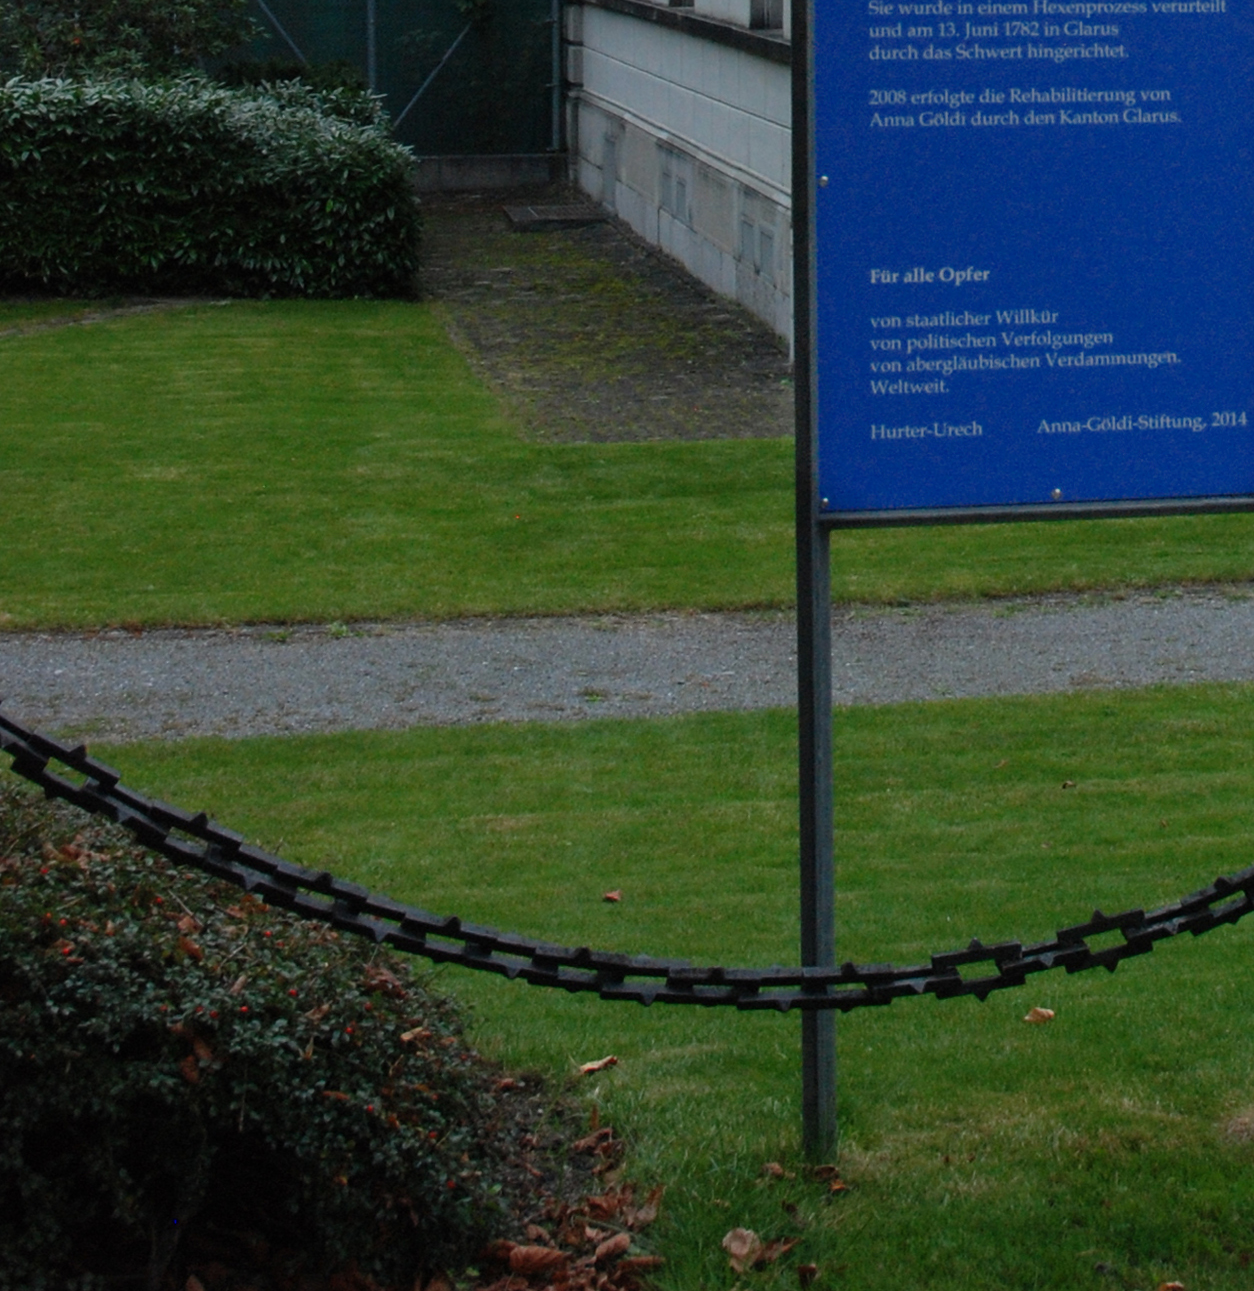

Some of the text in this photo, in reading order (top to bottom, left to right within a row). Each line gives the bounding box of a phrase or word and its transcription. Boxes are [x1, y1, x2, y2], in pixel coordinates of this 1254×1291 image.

[868, 0, 894, 16] Sie
[897, 0, 954, 16] wurde
[957, 0, 974, 15] in
[976, 0, 1029, 16] einem
[869, 20, 1120, 41] und am 13. Juni 1782 in Glarus
[868, 42, 1129, 64] durch das Schwert hingerichtet.
[868, 86, 1172, 109] 2008 erfolgte die Rehabilitierung von
[869, 107, 1182, 128] Anna Göldi durch den Kanton Glarus.
[870, 265, 991, 287] Für alle Opfer
[870, 308, 1059, 329] von staatlicher Willkür
[869, 329, 1114, 353] von politischen Verfolgungen
[870, 351, 1182, 374] von abergläubischen Verdammungen.
[870, 378, 950, 395] Weltweit.
[870, 420, 983, 440] Hurter-Urech
[1036, 411, 1248, 434] Anna-Göldi-Stiftung, 2014
